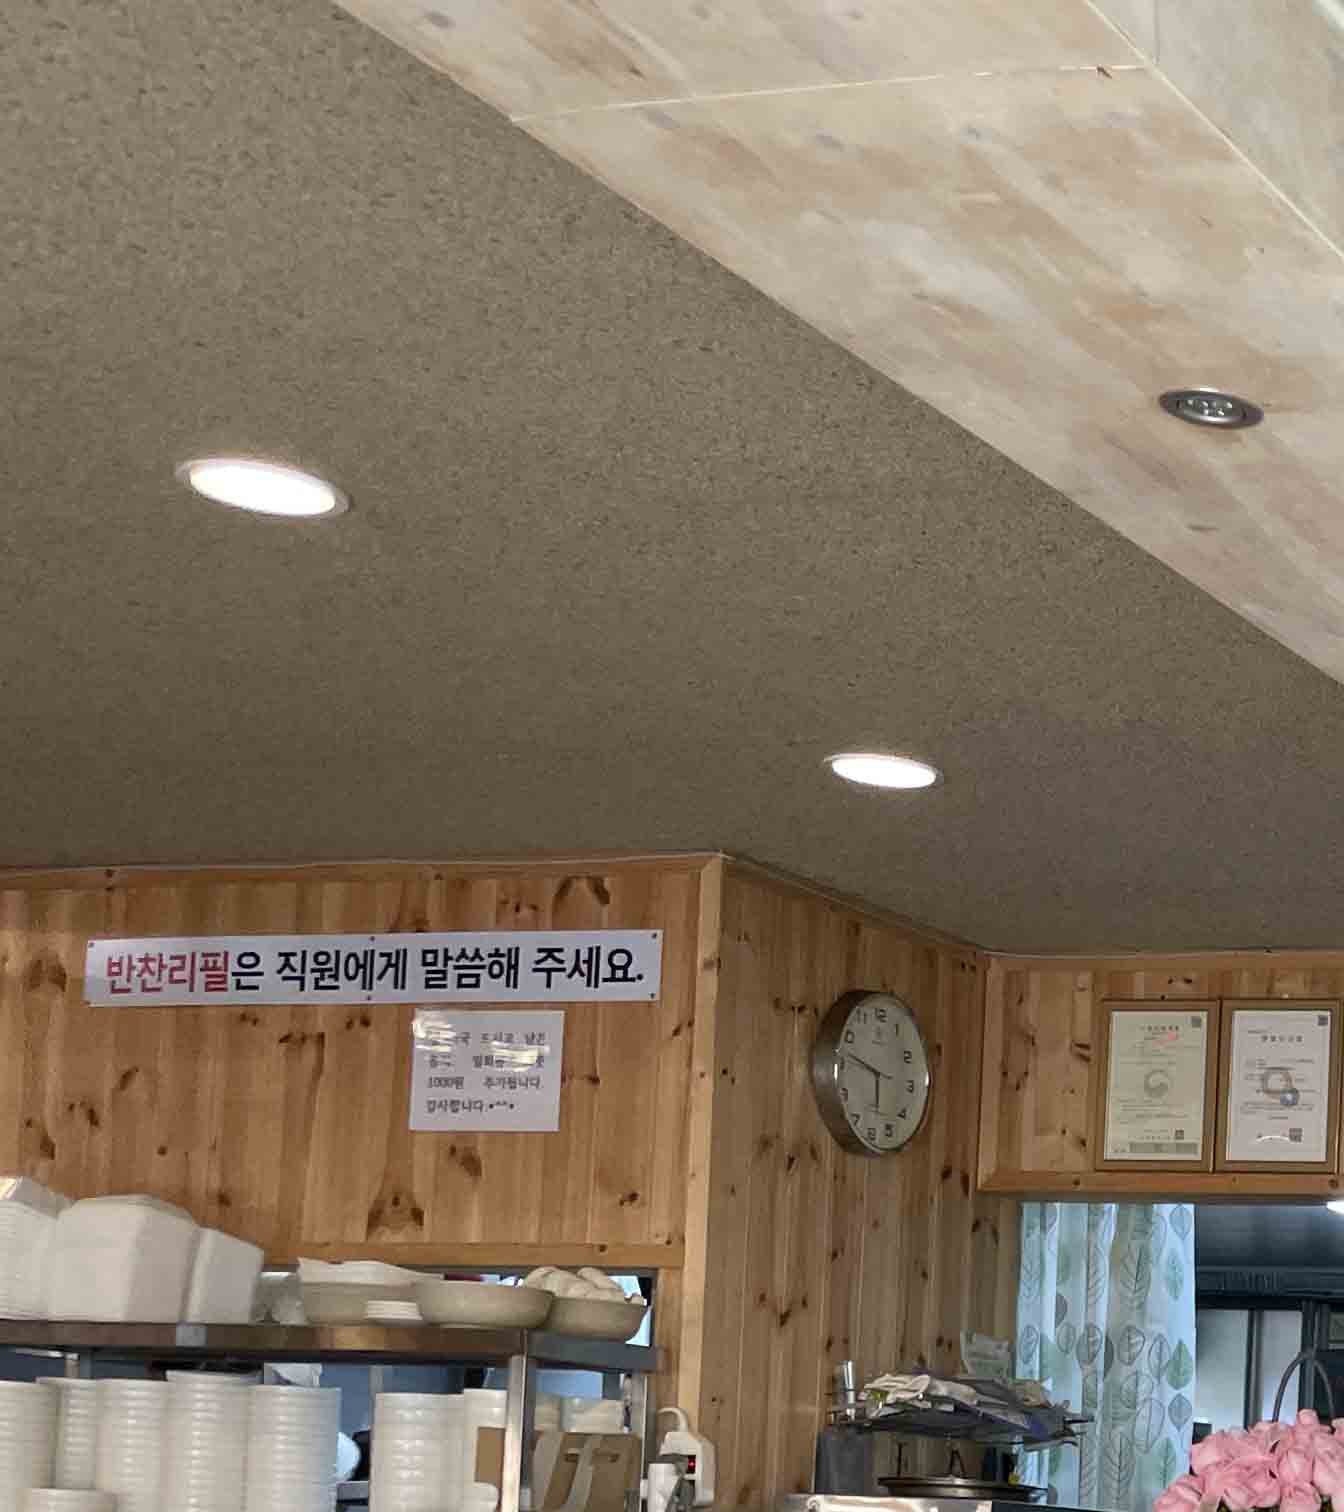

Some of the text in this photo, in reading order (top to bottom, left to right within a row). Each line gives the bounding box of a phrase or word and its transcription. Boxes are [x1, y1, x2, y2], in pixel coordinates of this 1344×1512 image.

[106, 947, 644, 995] 반찬리필은 직원에게 말씀해 주세요.
